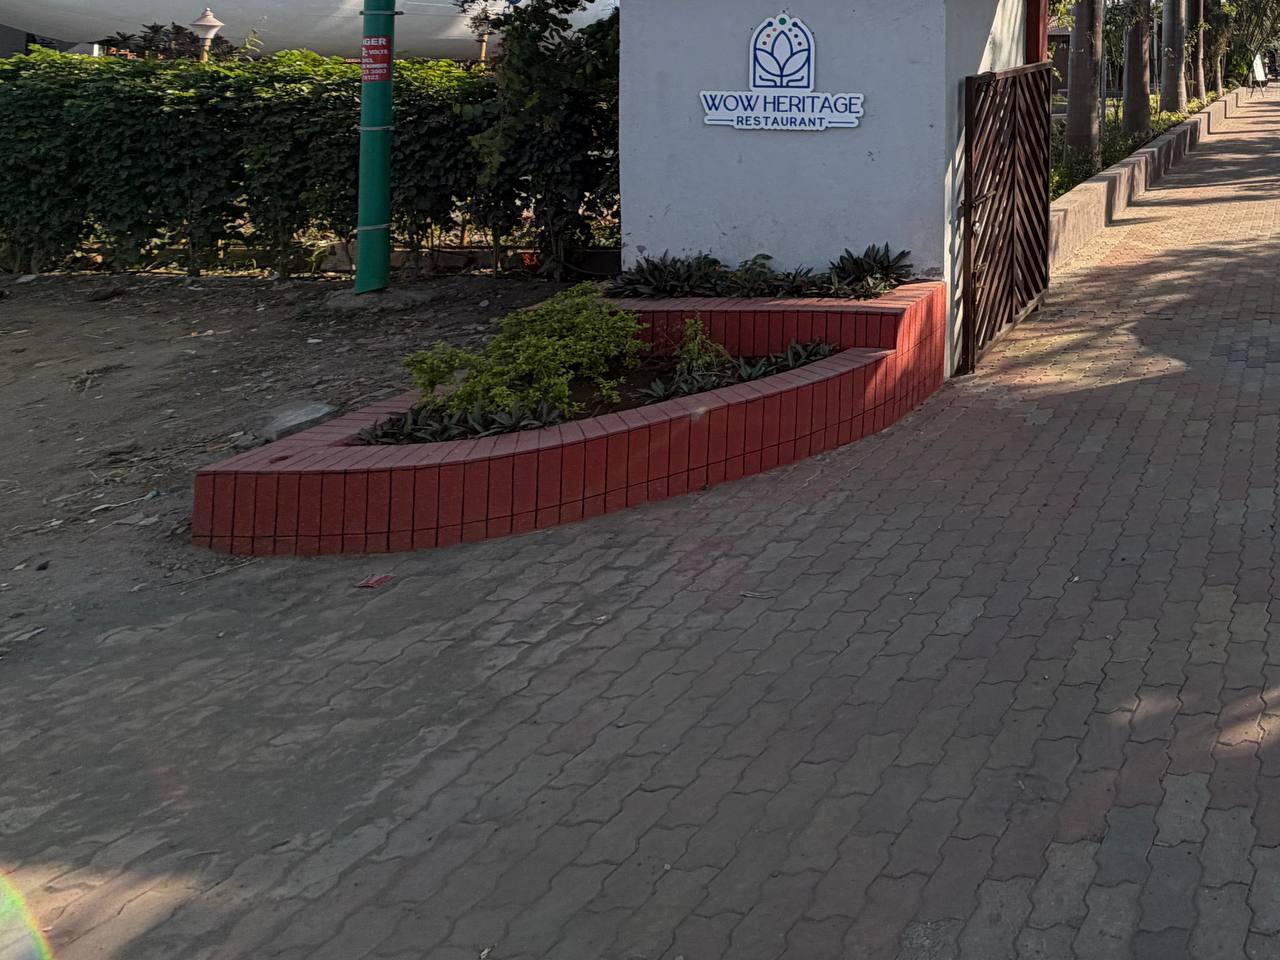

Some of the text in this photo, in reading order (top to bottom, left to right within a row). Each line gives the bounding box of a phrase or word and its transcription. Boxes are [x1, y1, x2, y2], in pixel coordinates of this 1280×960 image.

[702, 94, 861, 114] WOW HERITAGE
[736, 115, 826, 128] RESTAURANT
